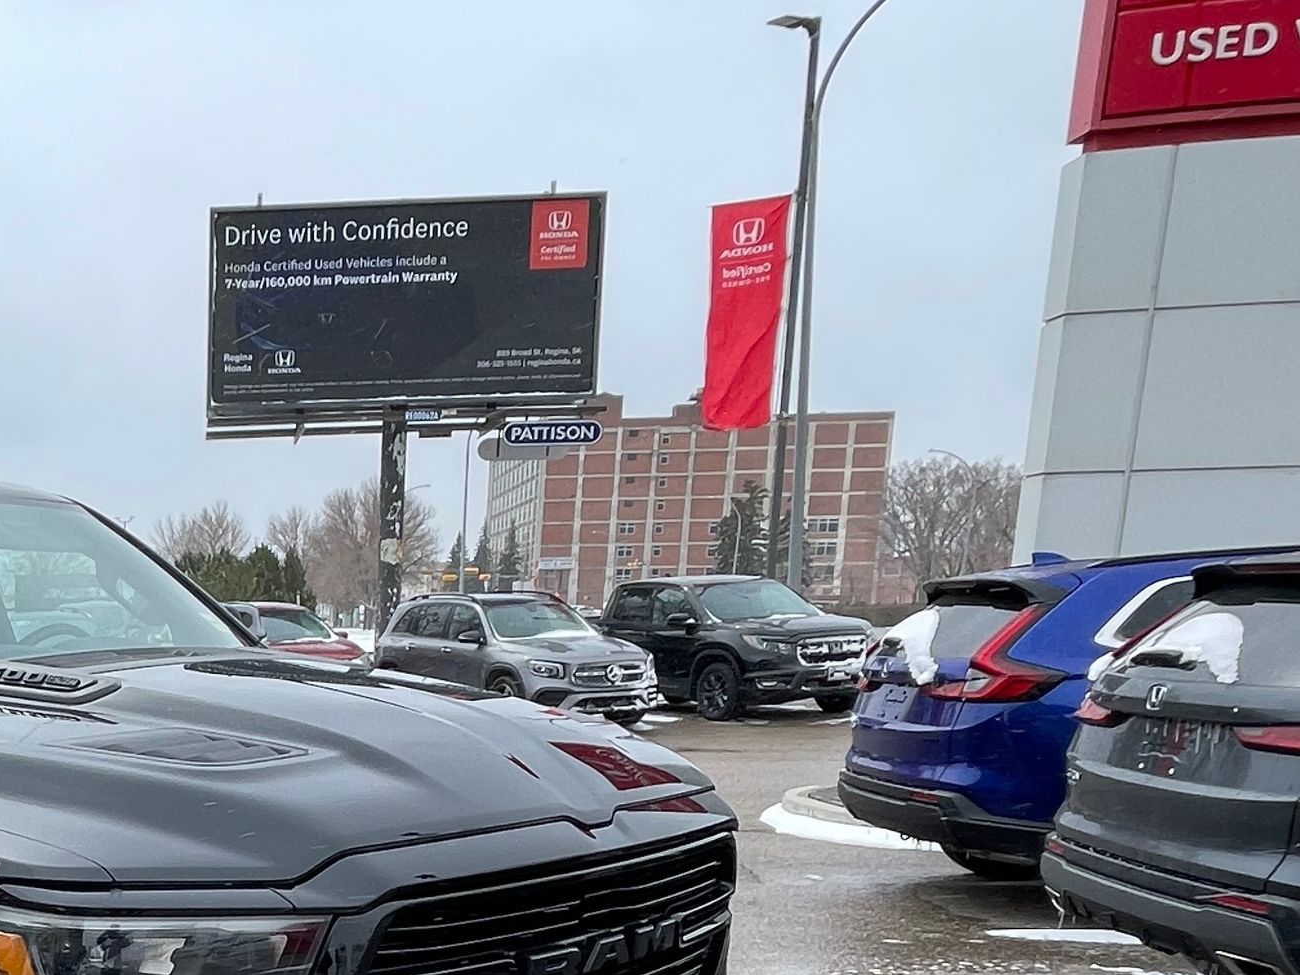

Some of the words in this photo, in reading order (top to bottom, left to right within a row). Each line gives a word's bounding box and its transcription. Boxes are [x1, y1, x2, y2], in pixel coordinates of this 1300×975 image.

[1151, 22, 1279, 66] USED
[224, 222, 282, 247] Drive
[288, 220, 335, 244] with
[342, 217, 469, 242] Confidence
[539, 230, 579, 239] HONDA
[540, 244, 577, 255] Certified
[224, 261, 260, 275] Honda
[263, 257, 312, 272] Certified
[315, 257, 343, 270] Used
[345, 255, 393, 269] Vehicles
[395, 254, 438, 267] include
[440, 256, 447, 267] a
[224, 275, 311, 290] 7-Year/160,000
[313, 274, 332, 286] km
[334, 272, 399, 286] Powertrain
[402, 270, 458, 285] Warranty
[223, 353, 253, 363] Regina
[224, 364, 252, 373] Honda
[511, 425, 595, 441] PATTISON
